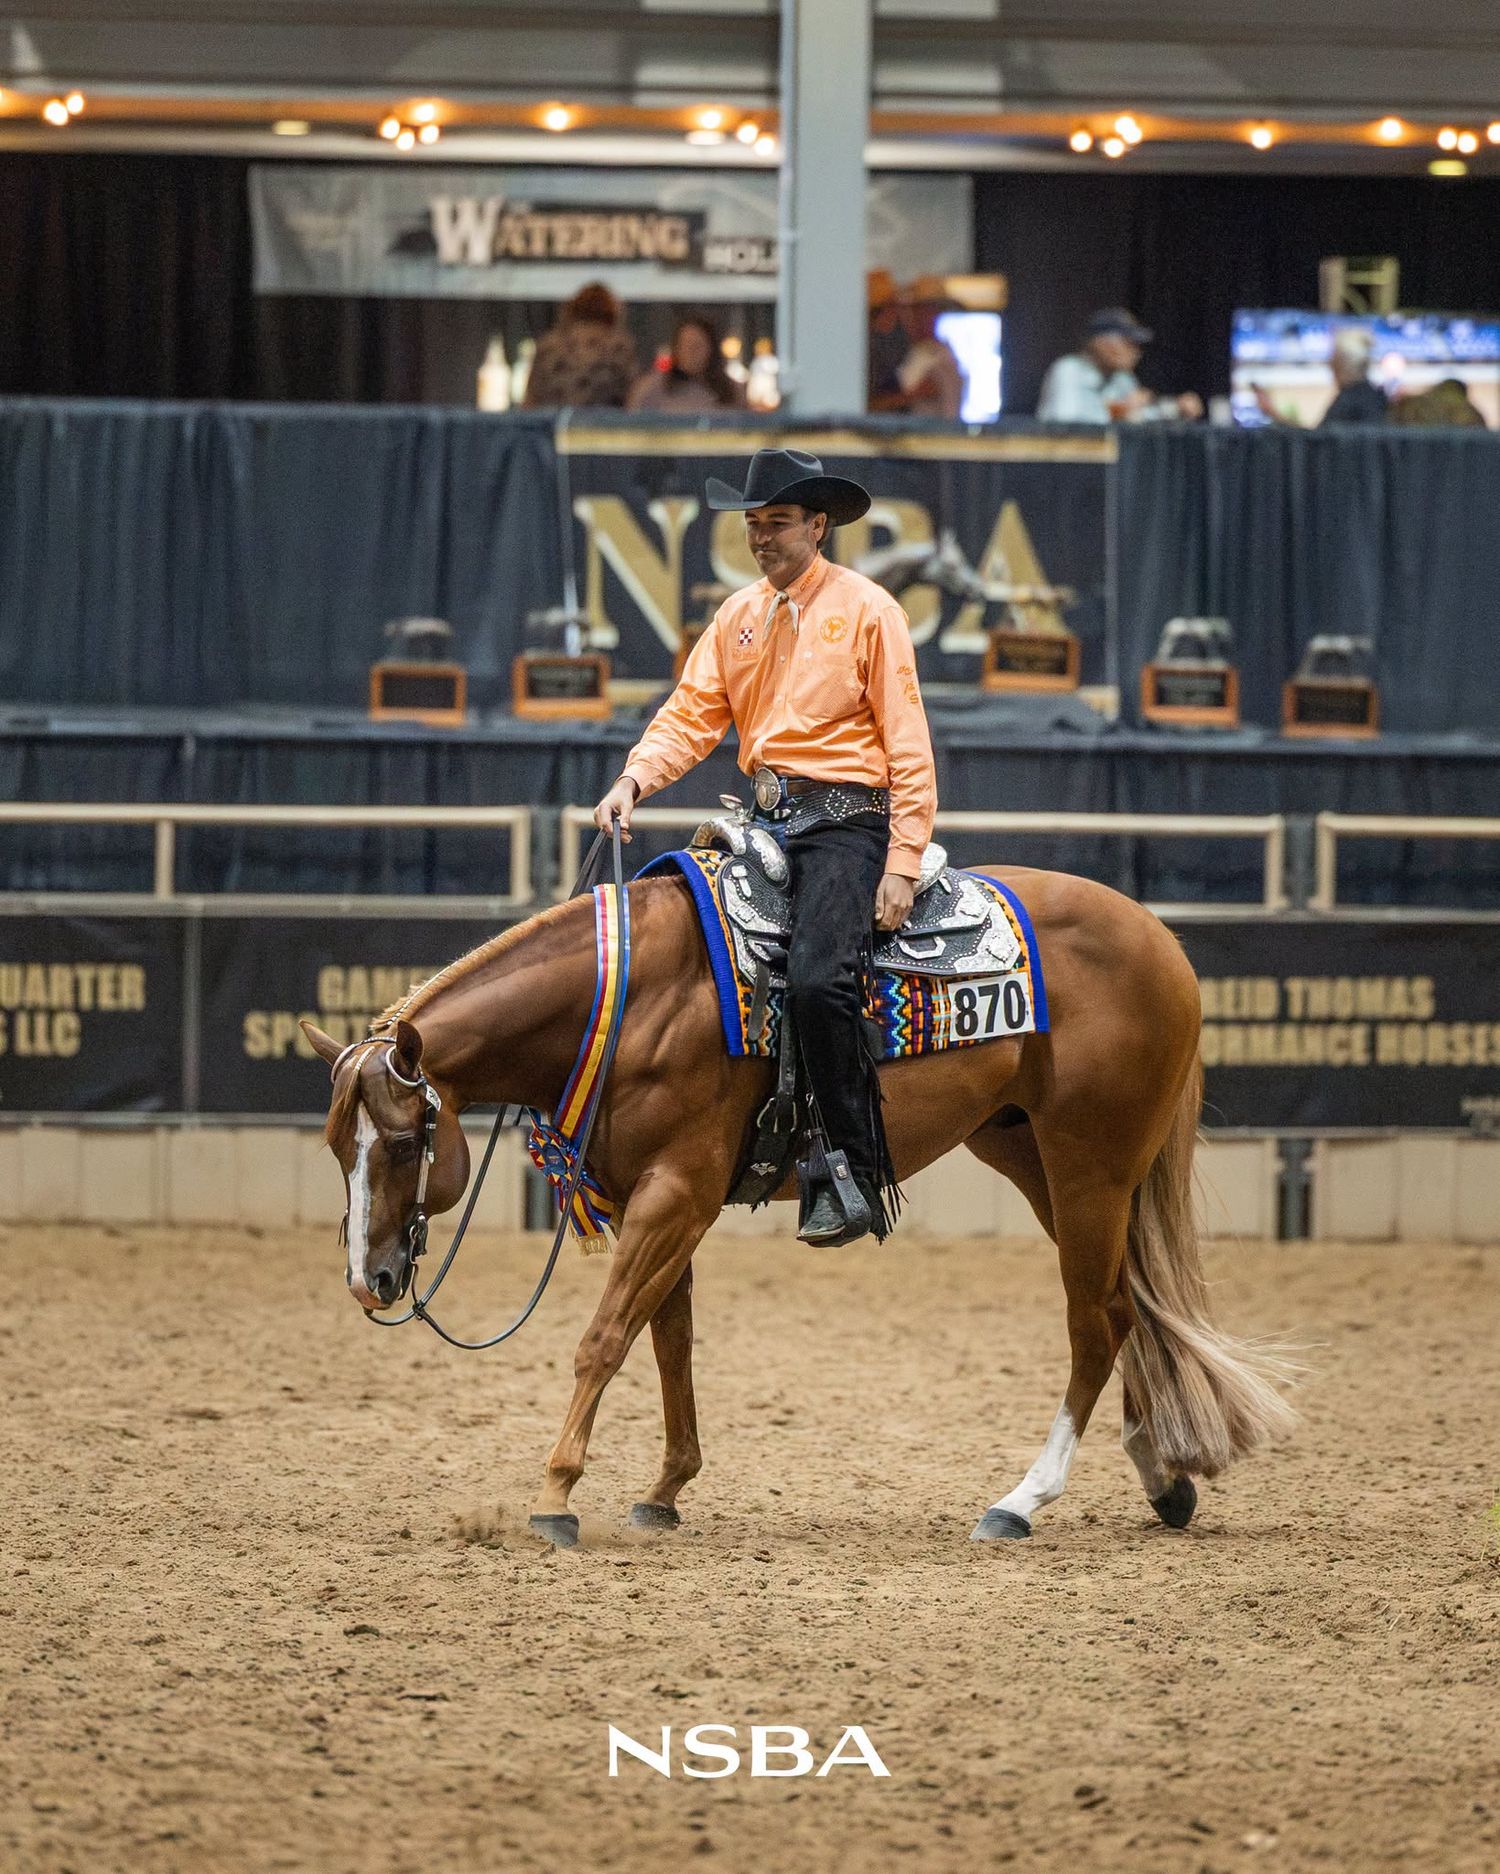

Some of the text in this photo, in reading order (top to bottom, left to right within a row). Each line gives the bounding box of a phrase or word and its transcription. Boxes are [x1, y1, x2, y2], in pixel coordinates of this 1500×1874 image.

[954, 980, 1026, 1036] 870
[1284, 976, 1435, 1019] THOMAS
[14, 1011, 81, 1057] LLC
